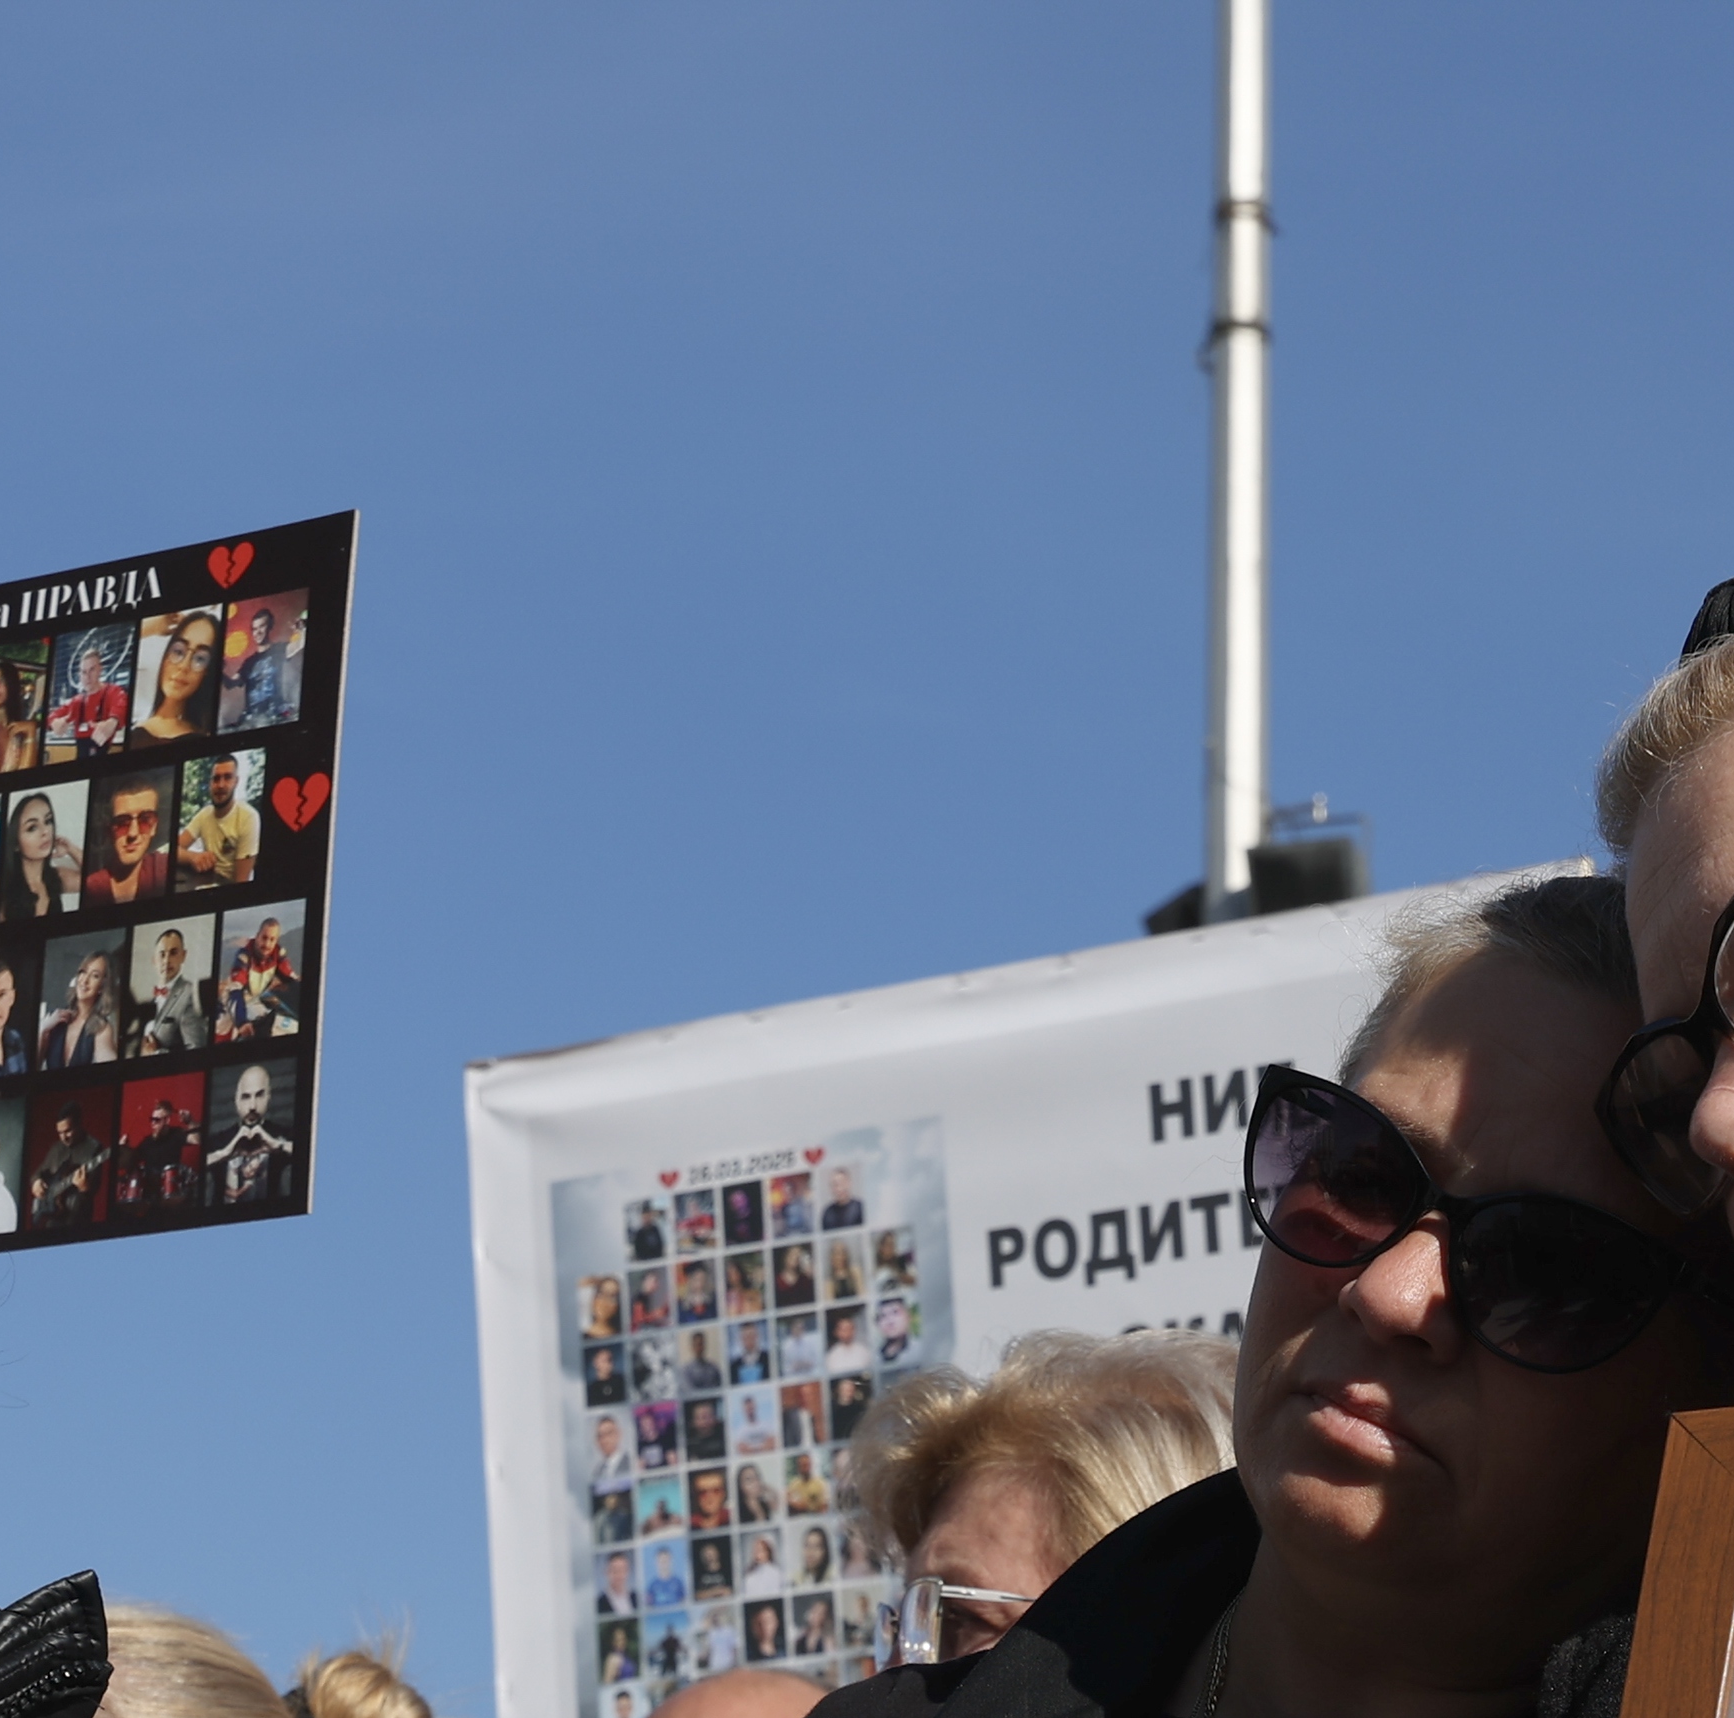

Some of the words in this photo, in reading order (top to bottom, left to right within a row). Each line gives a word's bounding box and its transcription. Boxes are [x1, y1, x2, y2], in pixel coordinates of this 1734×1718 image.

[19, 566, 163, 626] ПРАВДА
[1148, 1060, 1293, 1143] НИ
[988, 1185, 1277, 1289] РОДИТЕ
